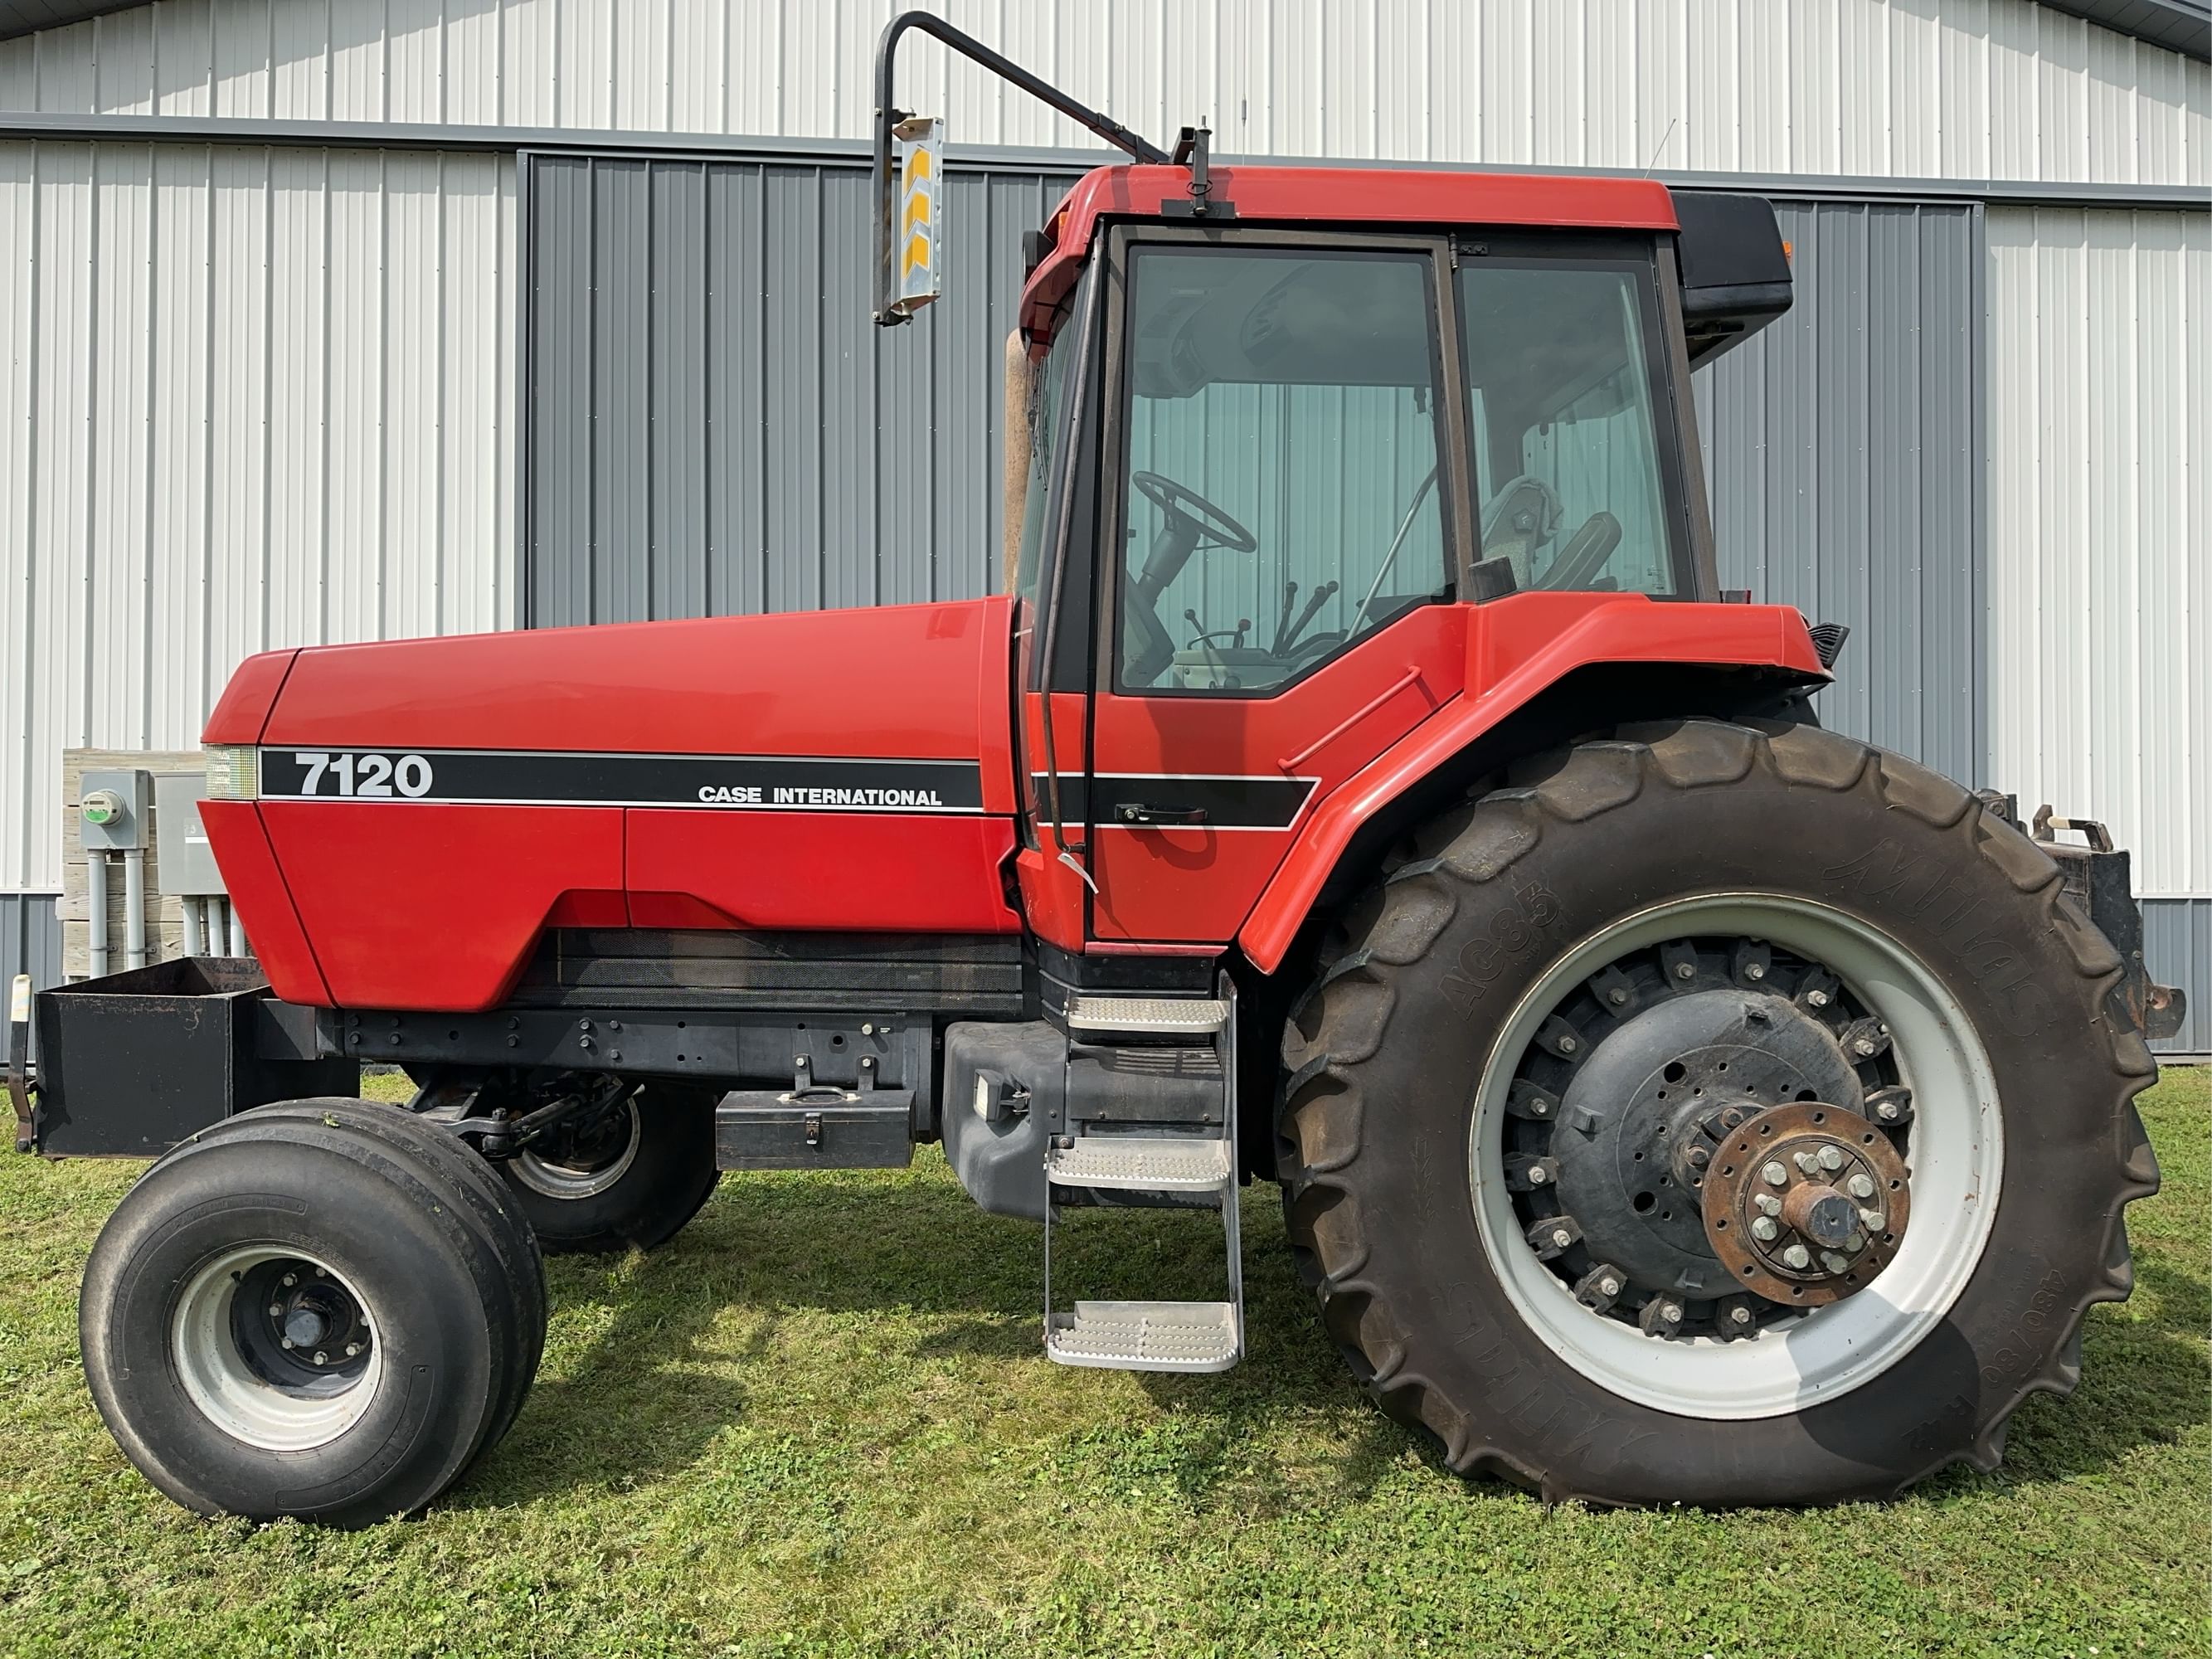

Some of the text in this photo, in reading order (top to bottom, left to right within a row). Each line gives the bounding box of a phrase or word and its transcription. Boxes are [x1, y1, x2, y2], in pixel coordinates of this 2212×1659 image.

[295, 752, 433, 797] 7120
[698, 786, 942, 806] CASE INTERNATIONAL
[1437, 880, 1561, 1021] AC85
